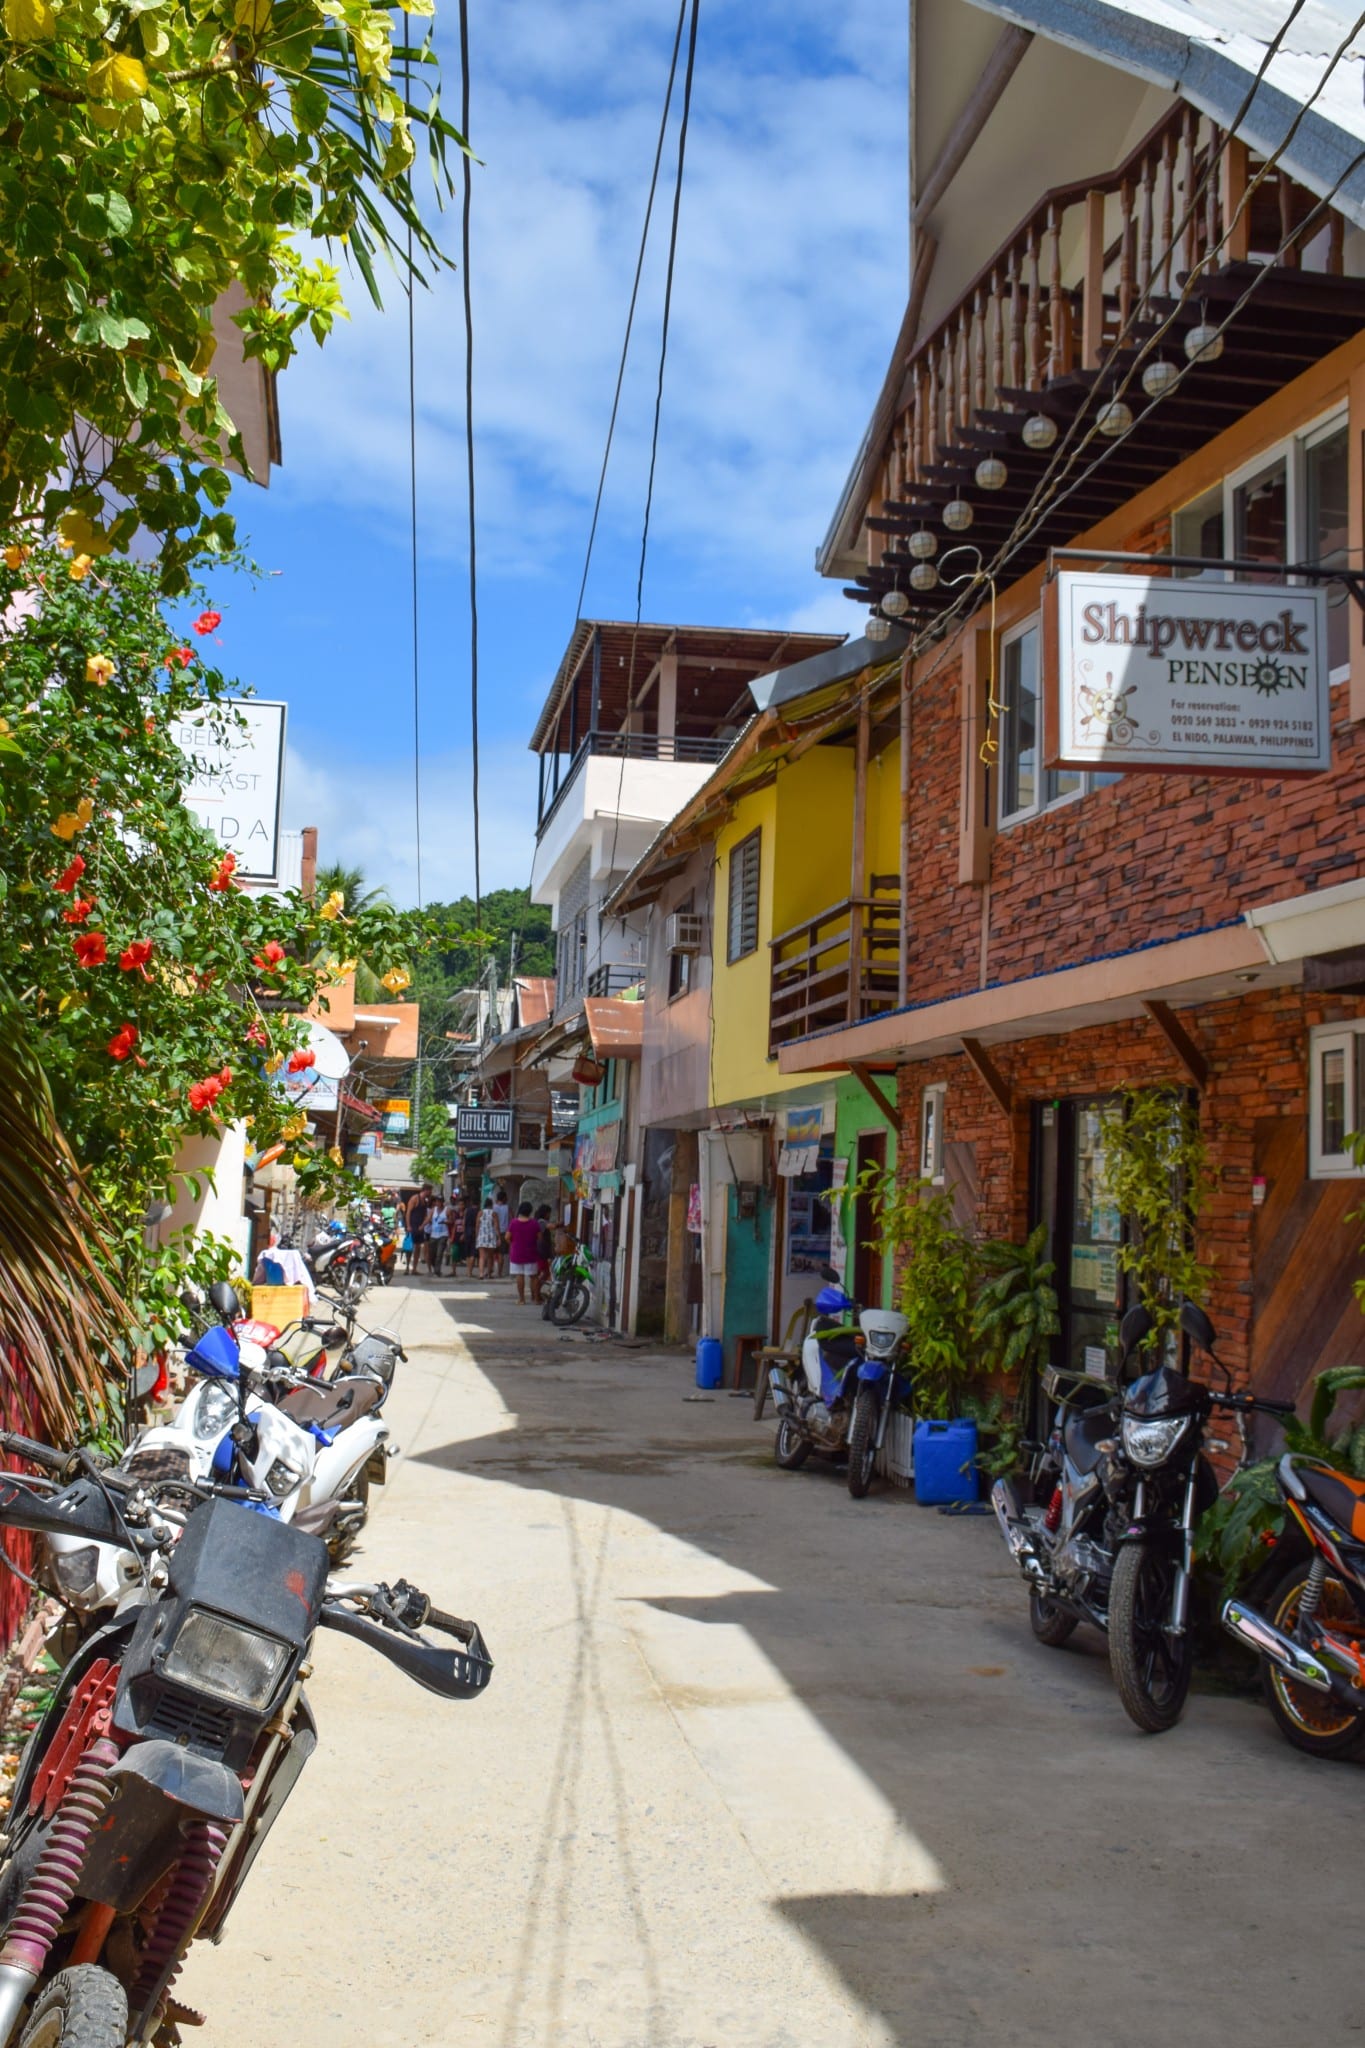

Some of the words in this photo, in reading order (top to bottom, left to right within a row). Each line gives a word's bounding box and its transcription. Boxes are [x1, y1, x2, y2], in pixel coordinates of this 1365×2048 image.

[1082, 601, 1310, 658] Shipwreck
[1168, 656, 1308, 697] PENSION
[1171, 699, 1185, 709] For
[1188, 700, 1241, 712] reservation:
[1171, 715, 1193, 726] 0920
[1195, 716, 1212, 726] 569
[1248, 718, 1271, 729] 0939
[1273, 719, 1289, 730] 924
[1291, 720, 1313, 731] 5182
[1172, 731, 1182, 742] EL
[1184, 732, 1212, 744] NIDO,
[1213, 733, 1258, 746] PALAWAN,
[1260, 735, 1314, 748] PHILIPPINES
[194, 772, 262, 791] KFAST
[461, 1113, 487, 1131] LITTLE
[489, 1114, 510, 1132] ITALY
